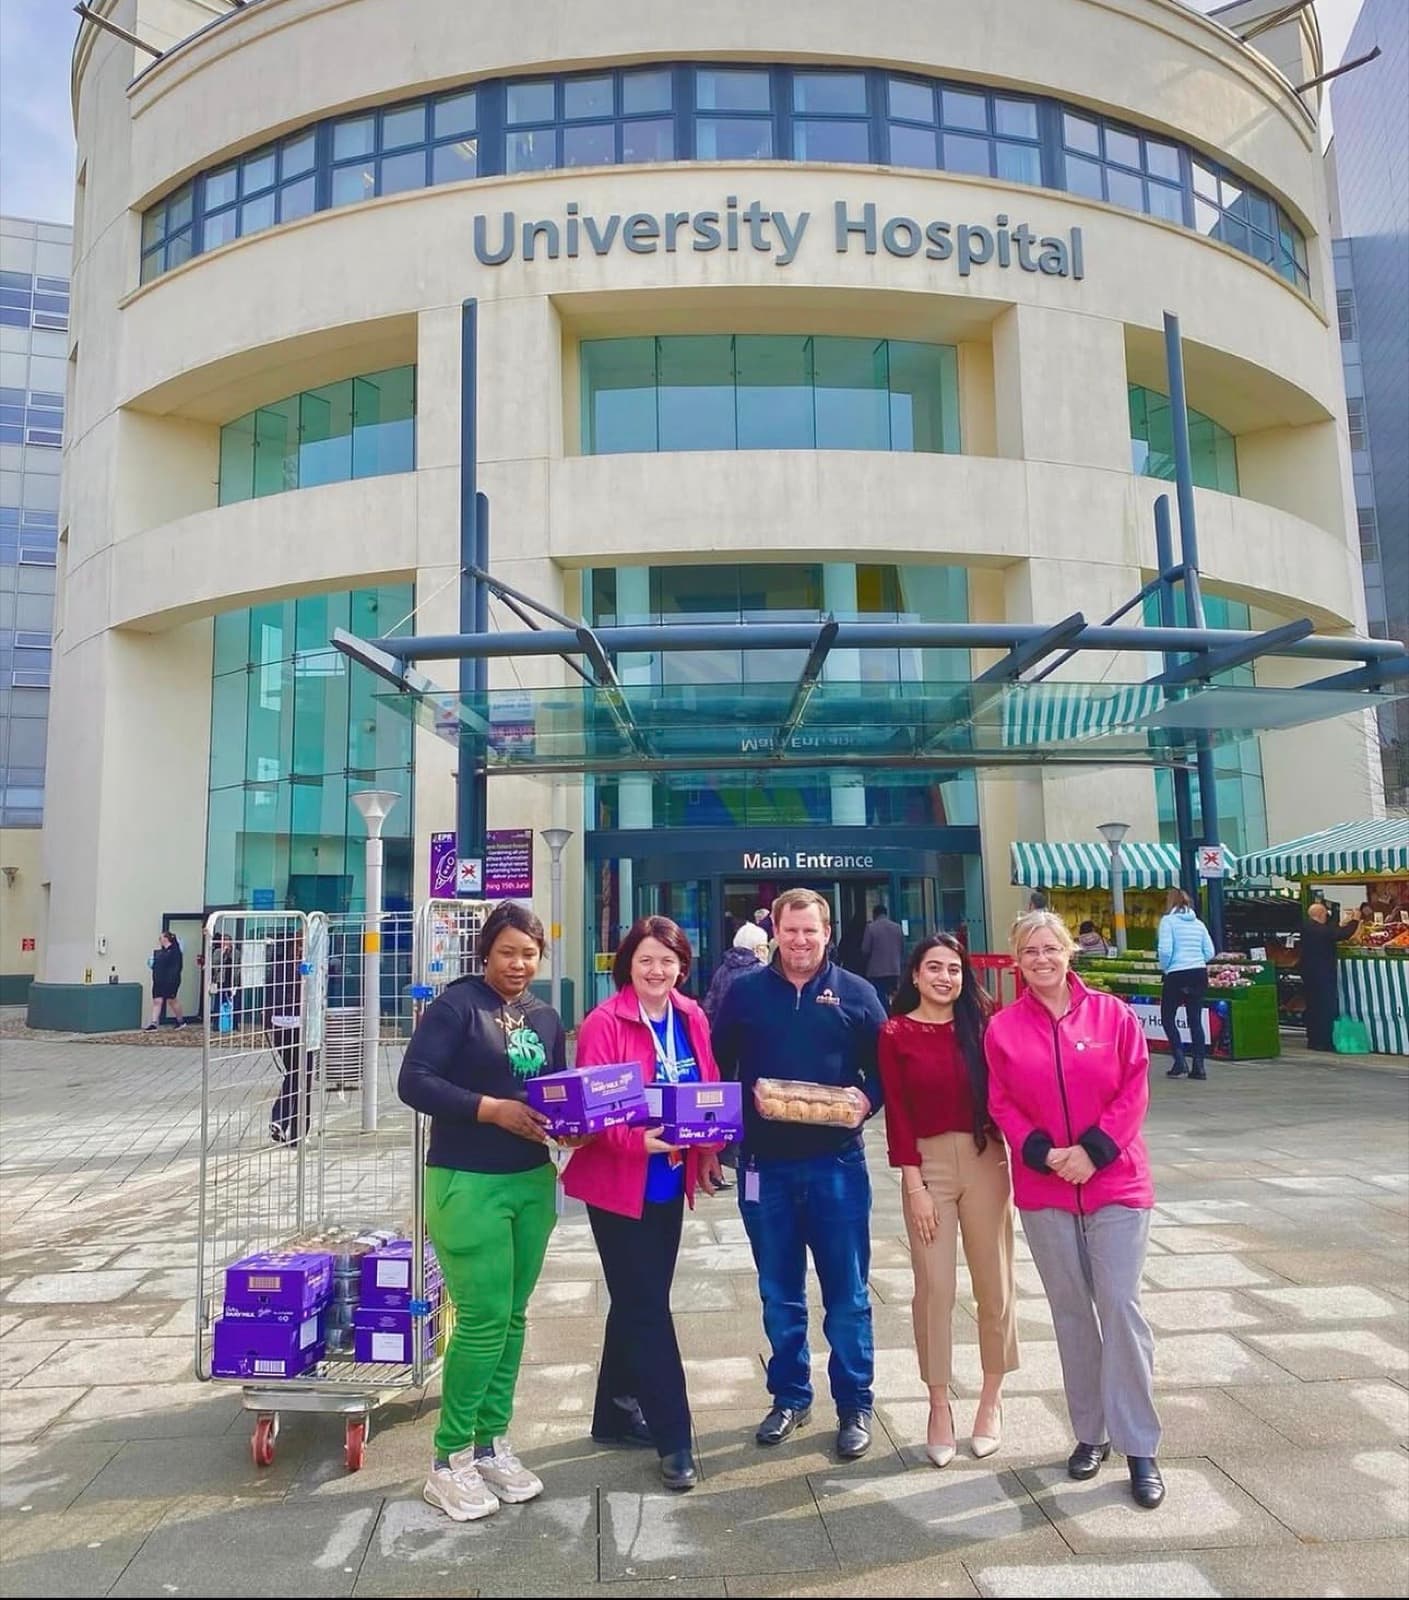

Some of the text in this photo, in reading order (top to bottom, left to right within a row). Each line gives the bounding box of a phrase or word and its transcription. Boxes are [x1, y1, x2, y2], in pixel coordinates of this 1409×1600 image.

[473, 196, 1084, 279] University Hospital
[743, 852, 874, 870] Main Entrance
